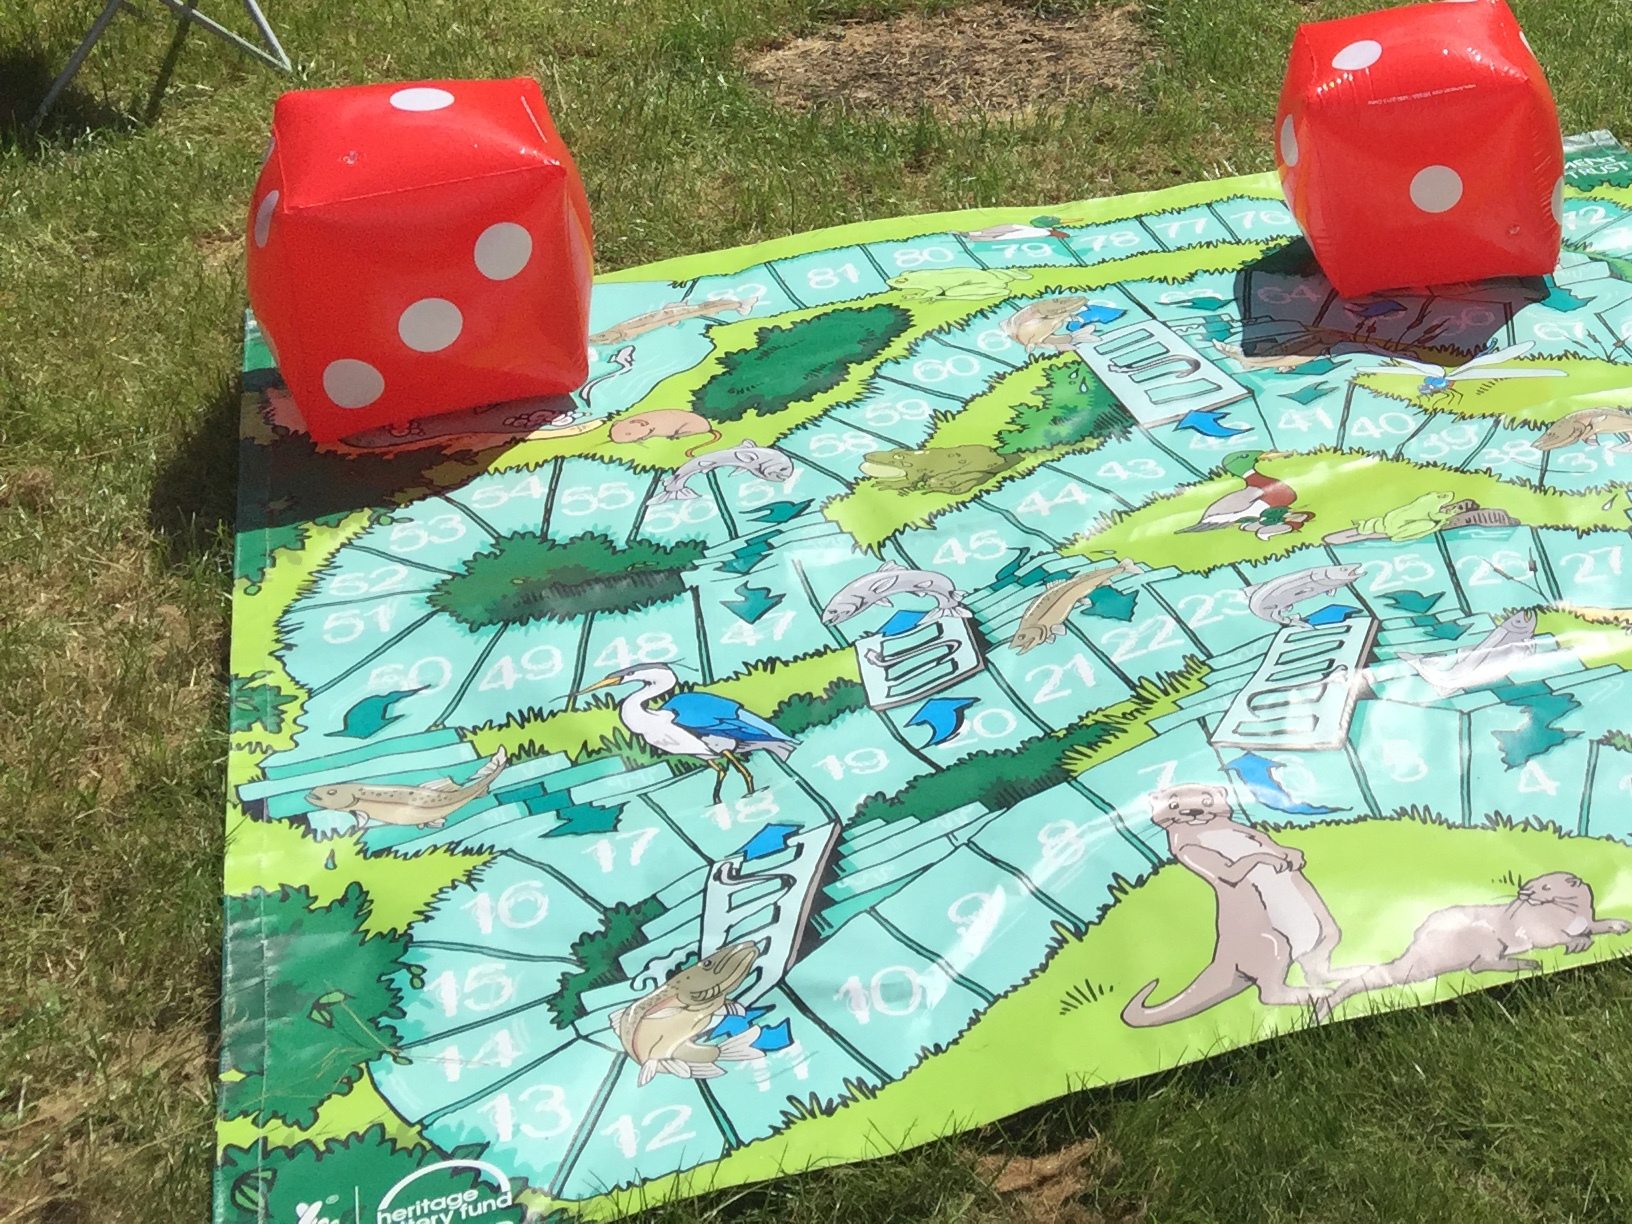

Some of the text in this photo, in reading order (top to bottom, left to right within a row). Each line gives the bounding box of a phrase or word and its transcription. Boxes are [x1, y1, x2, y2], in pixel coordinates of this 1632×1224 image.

[1565, 156, 1616, 169] MENT
[1155, 217, 1208, 239] 77
[1230, 210, 1291, 229] 76
[893, 246, 954, 267] 80
[991, 241, 1053, 261] 79
[1080, 231, 1142, 252] 78
[806, 263, 860, 289] 81
[1257, 284, 1322, 305] 64
[912, 354, 981, 384] 60
[864, 398, 932, 427] 59
[1278, 407, 1334, 432] 41
[1350, 411, 1416, 438] 40
[808, 431, 879, 458] 58
[1420, 425, 1479, 458] 39
[1478, 437, 1541, 464] 38
[1096, 458, 1166, 480] 43
[470, 475, 545, 511] 54
[561, 482, 636, 517] 55
[1016, 483, 1091, 517] 44
[390, 514, 467, 552] 53
[933, 529, 1008, 565] 45
[328, 564, 409, 598] 52
[1357, 553, 1435, 592] 25
[1456, 550, 1536, 586] 26
[1559, 545, 1624, 583] 27
[323, 600, 399, 645] 51
[1177, 588, 1249, 625] 23
[720, 610, 797, 646] 47
[1100, 623, 1185, 663] 22
[593, 631, 679, 669] 48
[366, 655, 453, 696] 50
[478, 644, 565, 693] 49
[1025, 651, 1097, 705] 21
[814, 747, 890, 780] 19
[1137, 760, 1178, 790] 7
[1517, 760, 1561, 796] 4
[702, 788, 779, 831] 18
[582, 827, 661, 873] 17
[1037, 818, 1085, 867] 8
[461, 879, 550, 935] 16
[947, 886, 1006, 948] 9
[424, 961, 515, 1017] 15
[833, 964, 923, 1025] 10
[427, 1029, 524, 1083] 14
[734, 1039, 812, 1093] 11
[477, 1083, 572, 1143] 13
[600, 1103, 697, 1159] 12
[377, 1189, 479, 1224] heritage
[460, 1191, 514, 1220] fund
